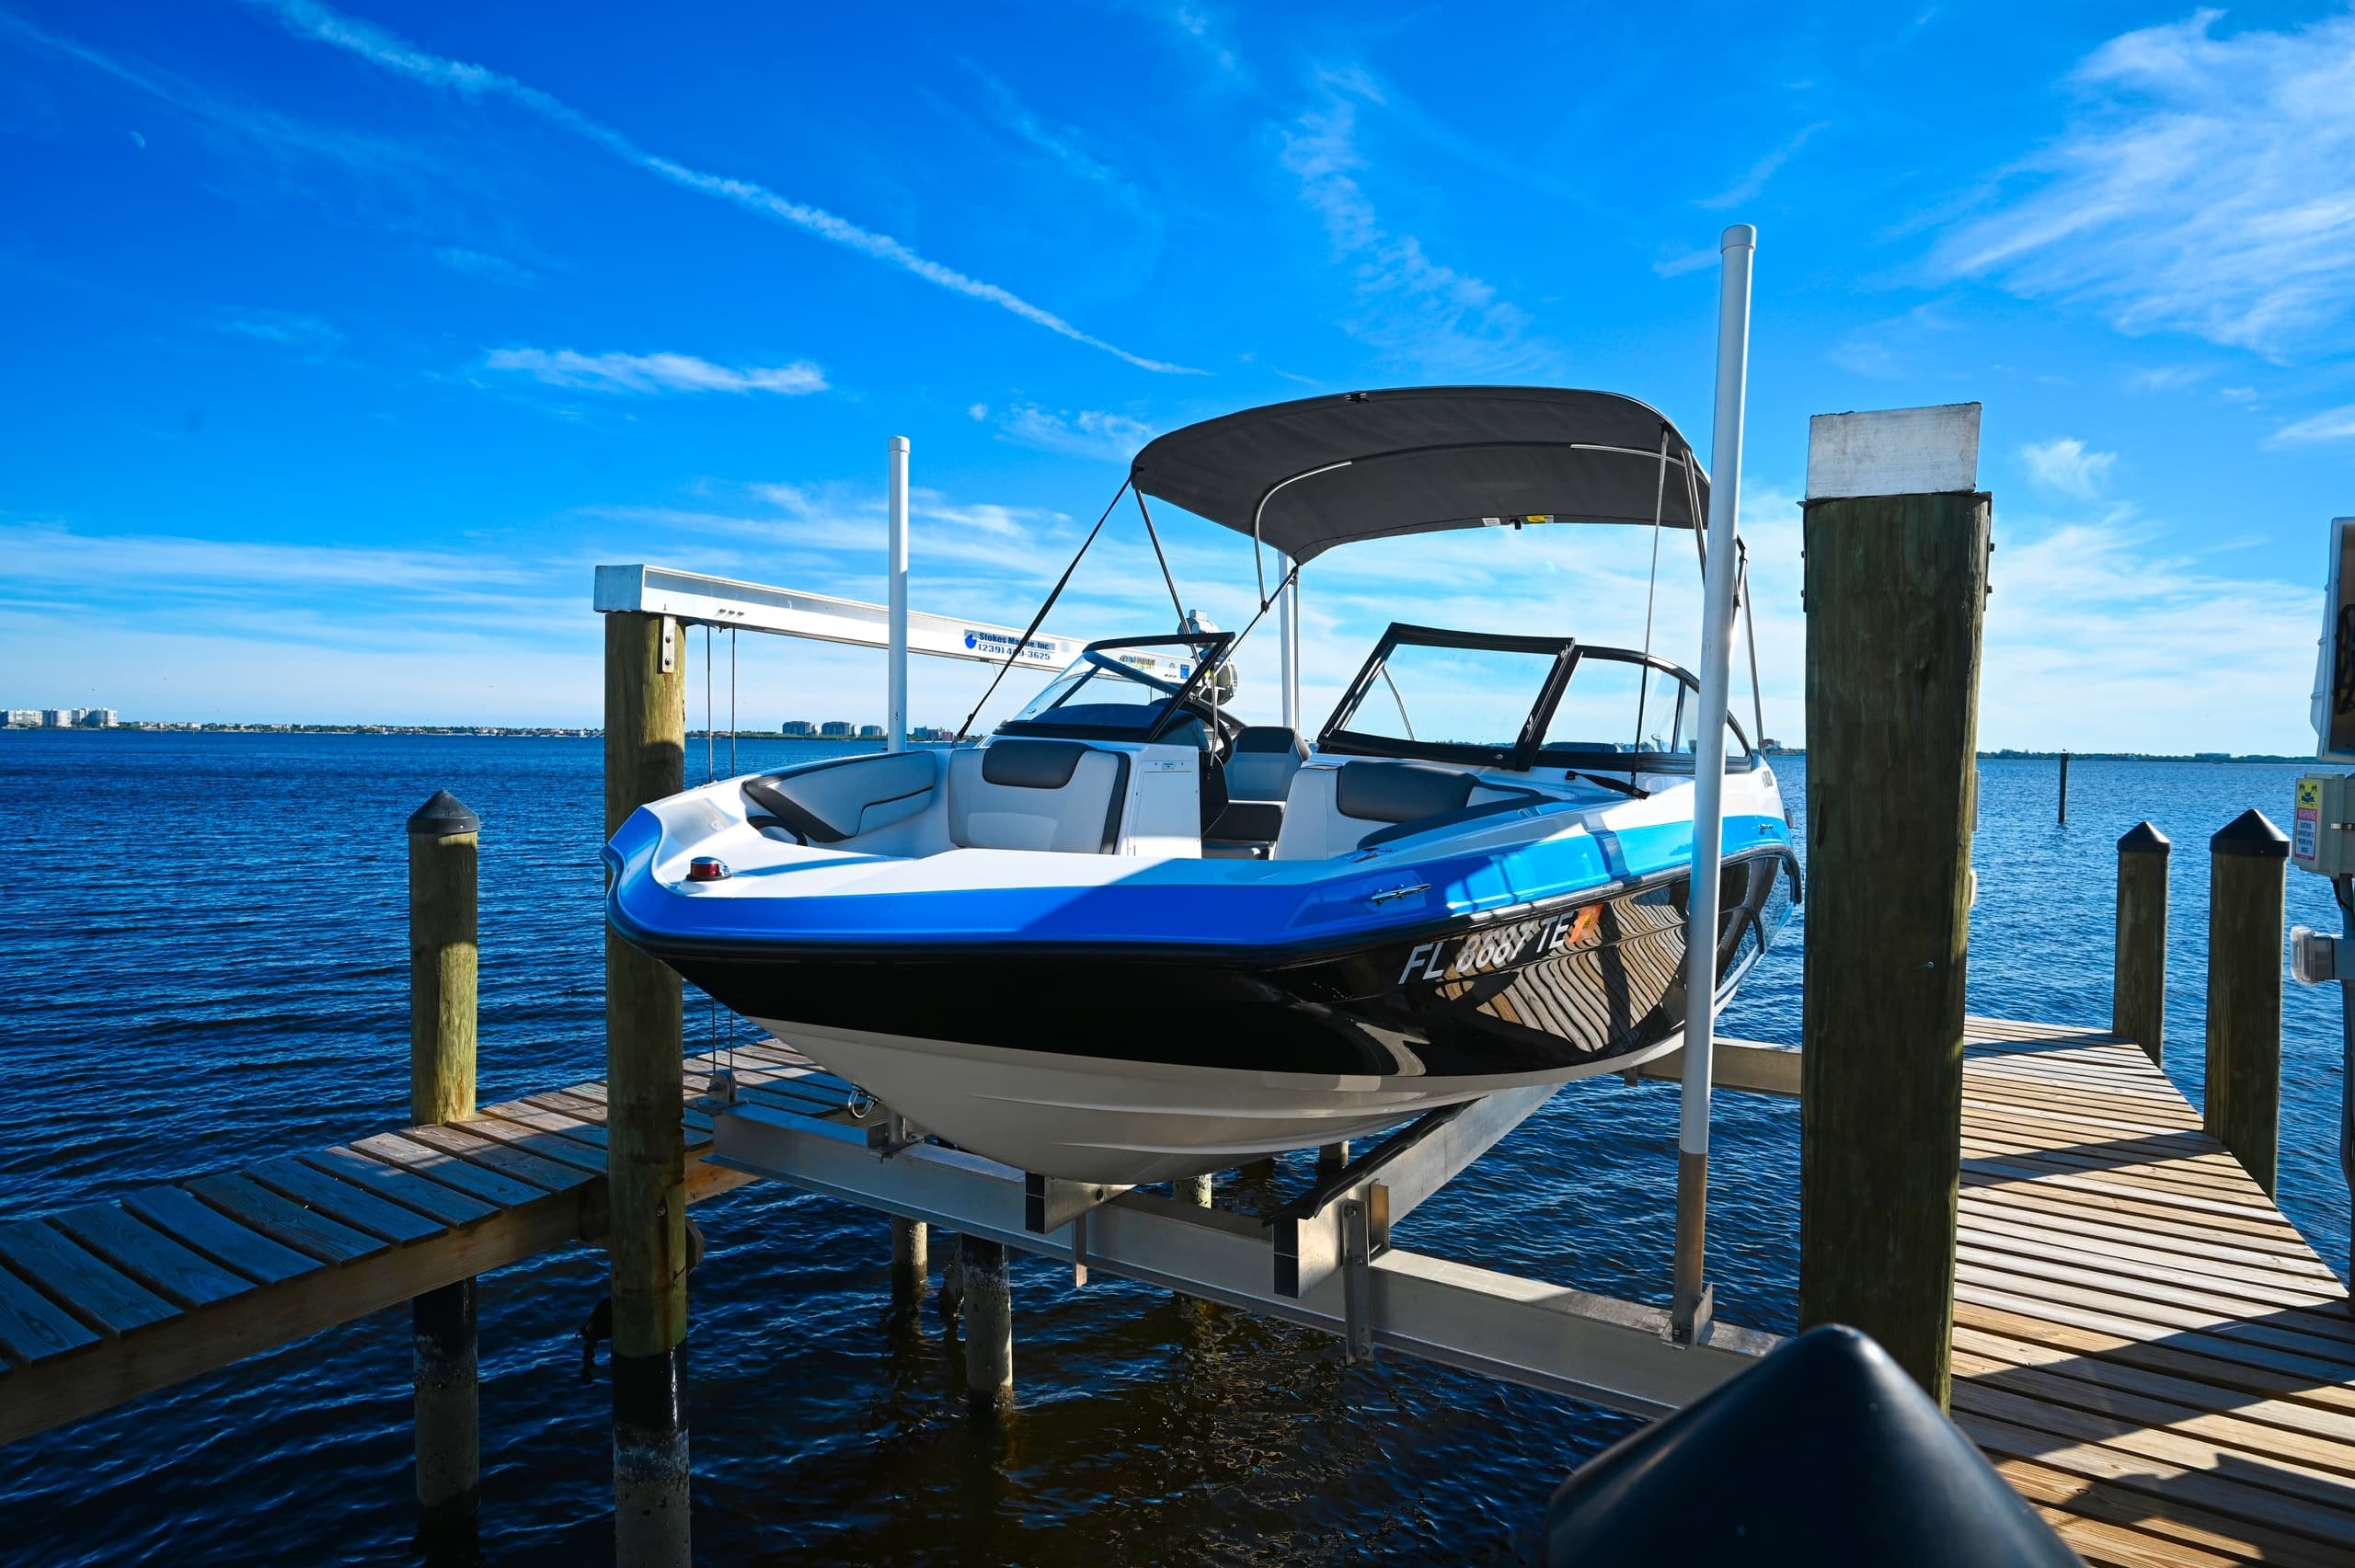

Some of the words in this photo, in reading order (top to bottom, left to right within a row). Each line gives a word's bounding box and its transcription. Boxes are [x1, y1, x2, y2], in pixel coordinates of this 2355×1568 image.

[979, 632, 1007, 644] Stokes
[978, 643, 1005, 654] (239)
[1006, 647, 1051, 660] 49-3625
[1397, 941, 1445, 985] FL
[1455, 920, 1535, 974] 8687
[1535, 910, 1580, 953] TE
